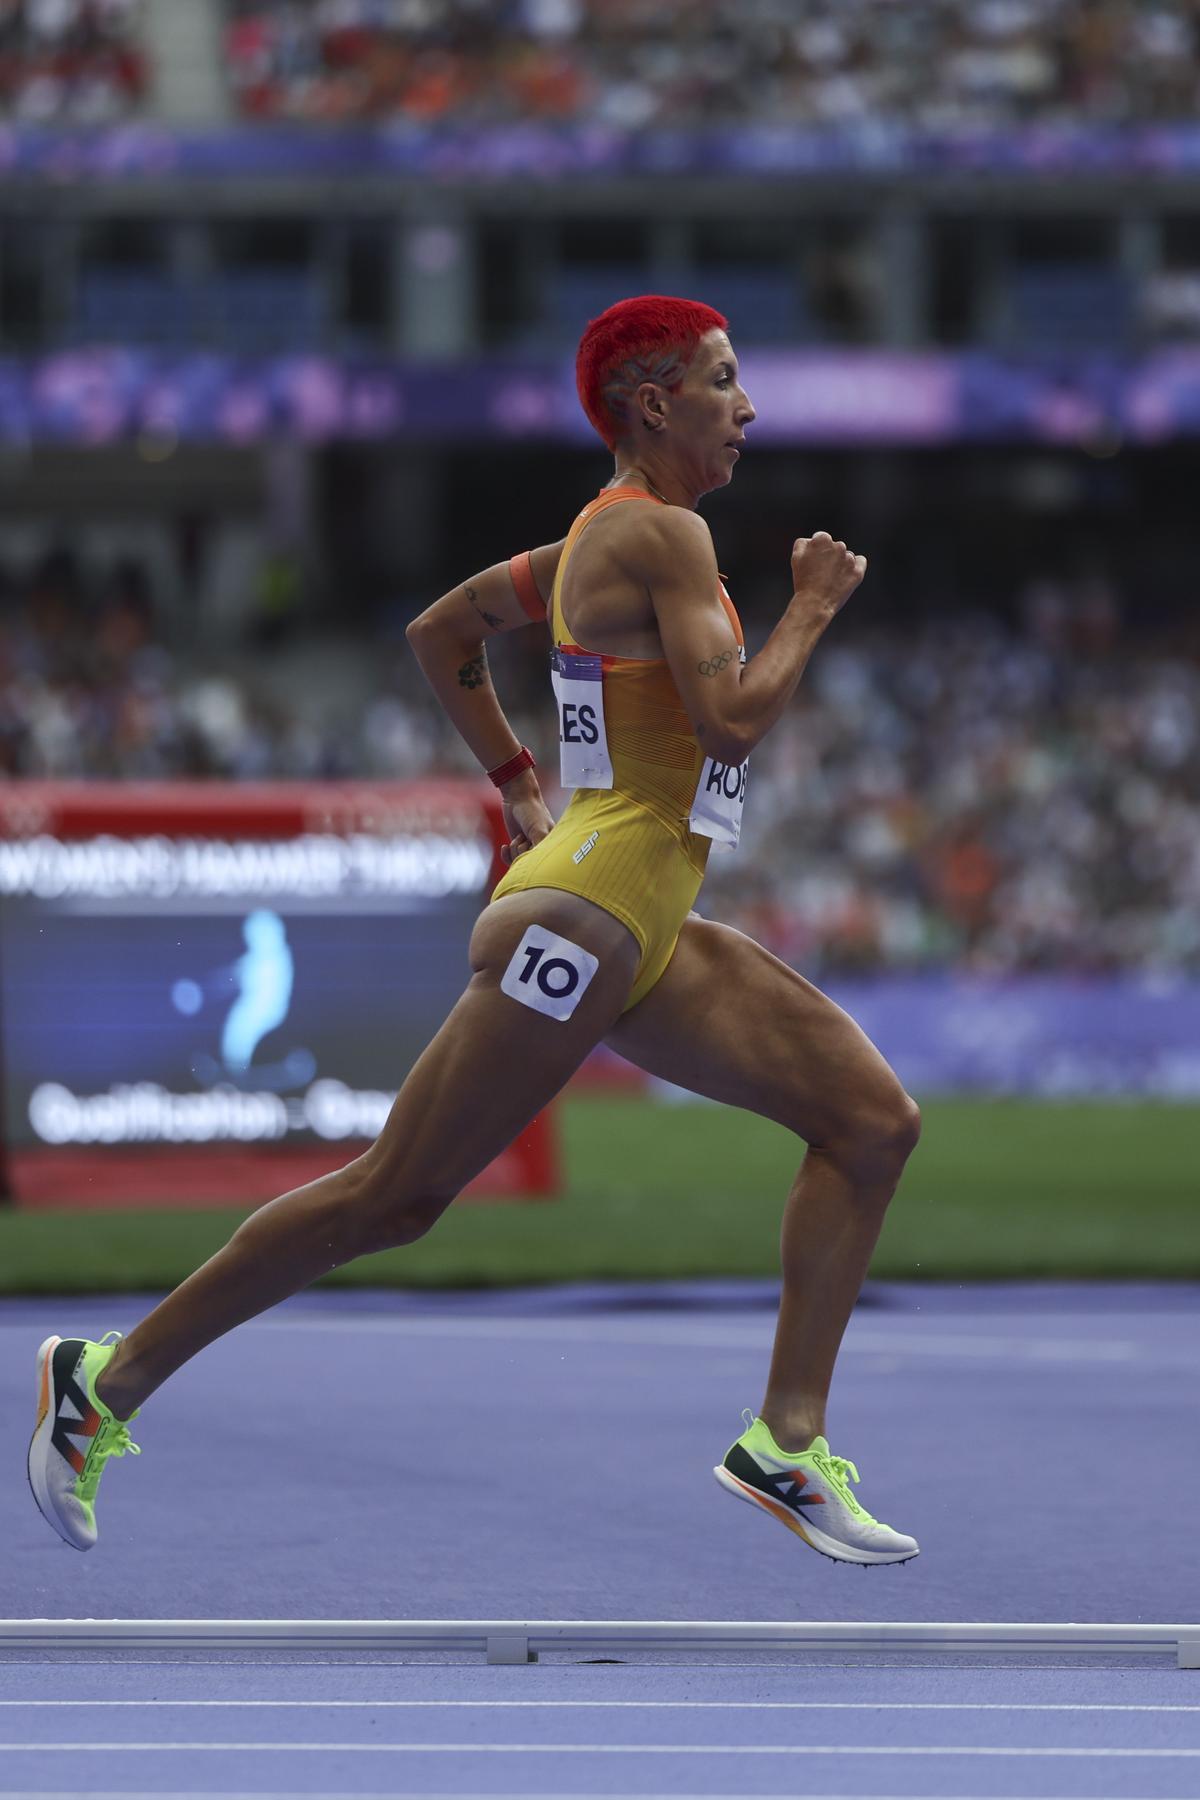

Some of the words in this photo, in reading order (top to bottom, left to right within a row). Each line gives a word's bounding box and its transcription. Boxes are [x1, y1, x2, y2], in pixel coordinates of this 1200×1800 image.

[559, 703, 599, 745] ES
[572, 830, 600, 865] ESP
[518, 945, 579, 999] 10
